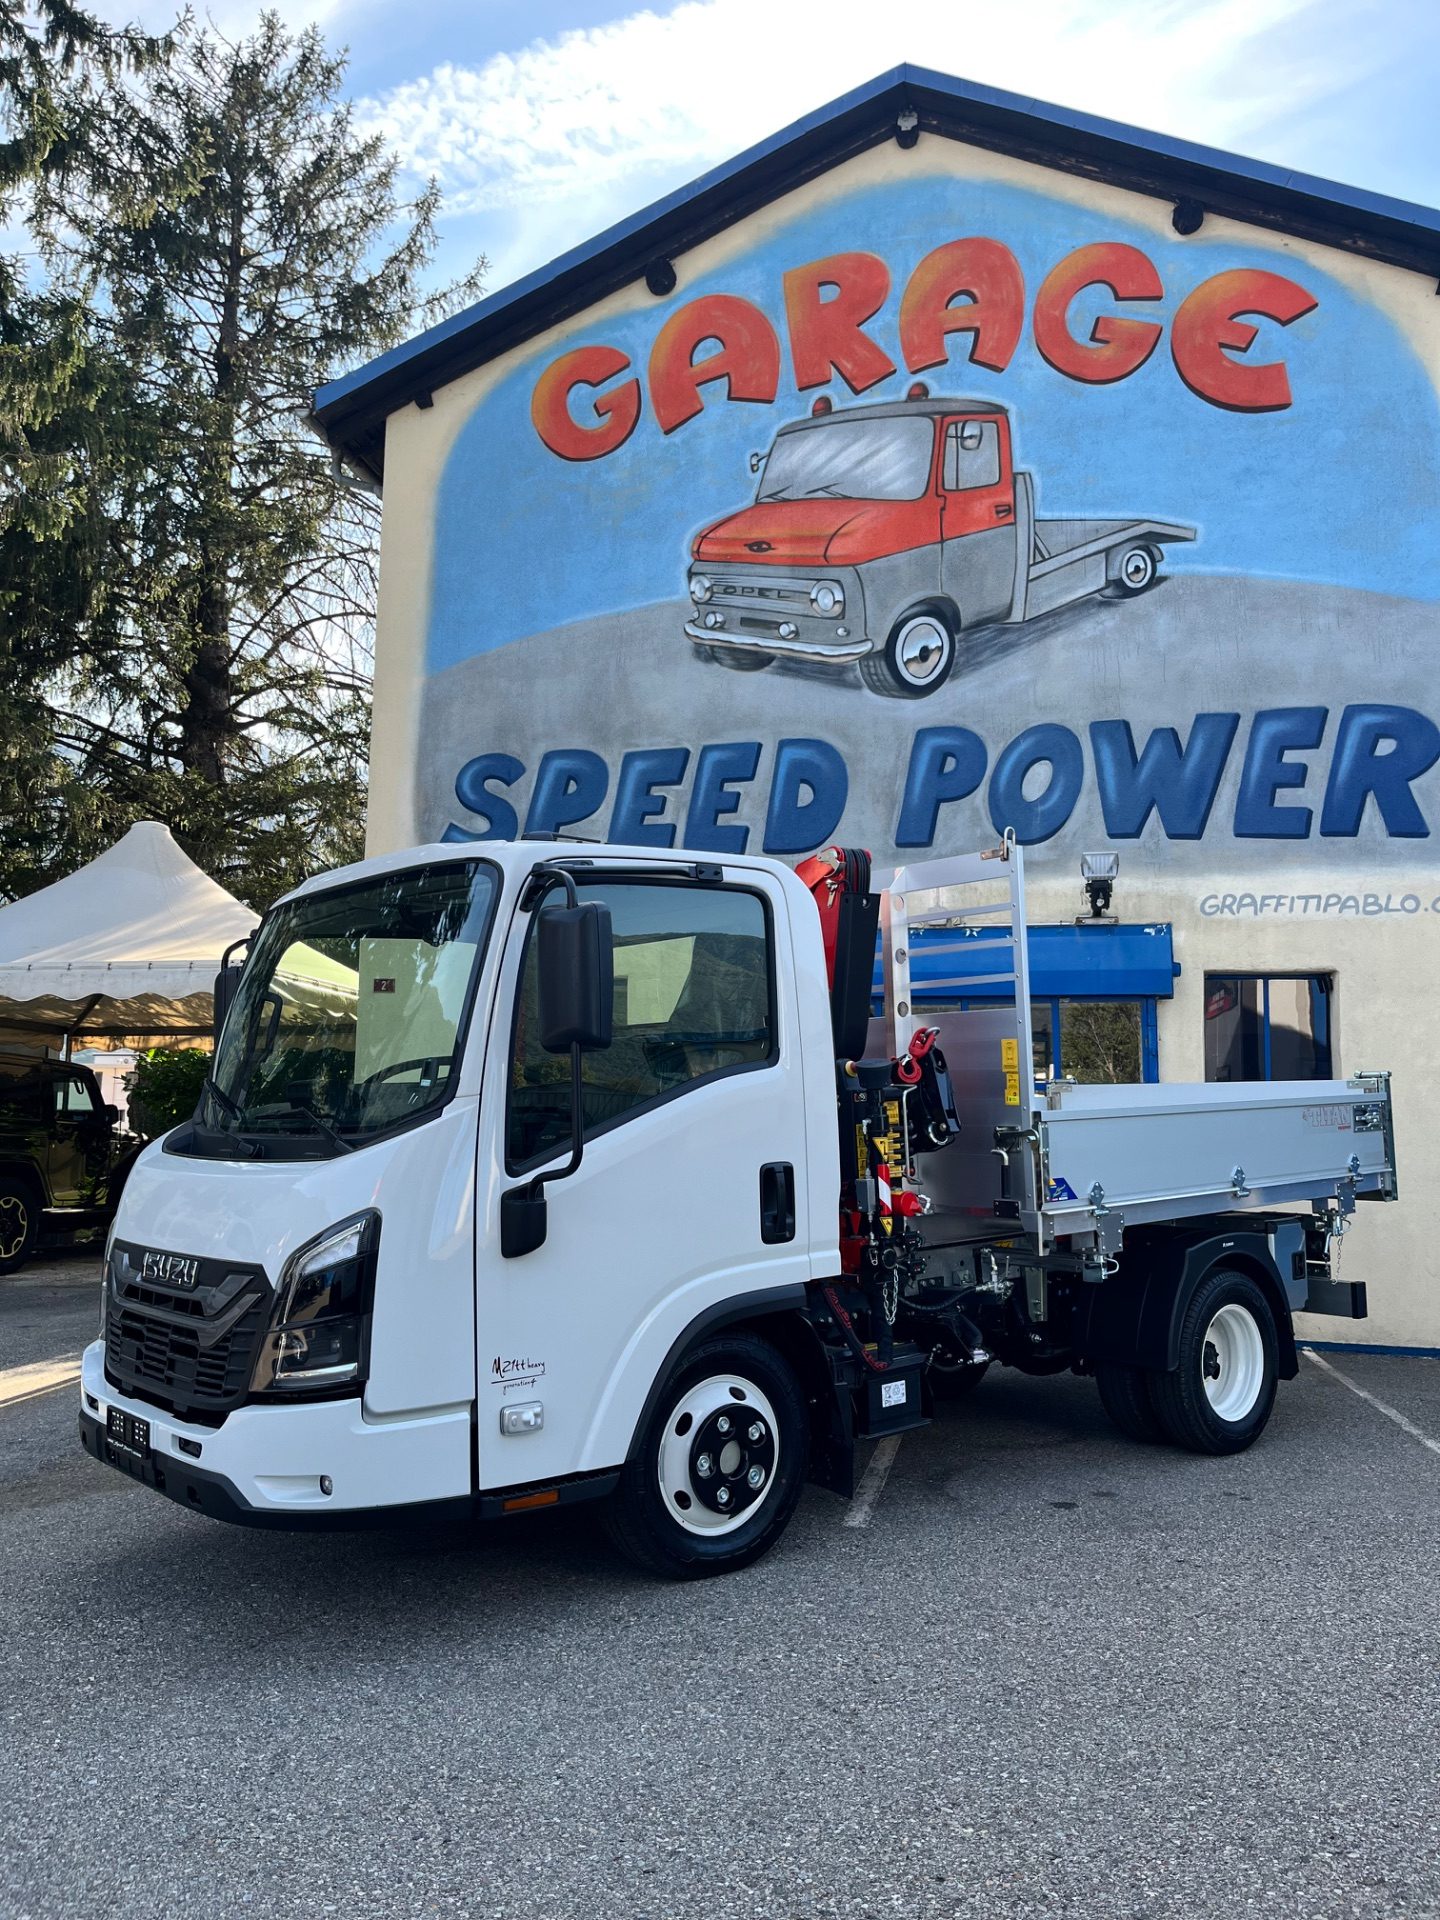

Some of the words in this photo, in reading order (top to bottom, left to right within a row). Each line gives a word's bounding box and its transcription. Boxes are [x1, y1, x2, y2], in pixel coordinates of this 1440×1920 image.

[531, 236, 1319, 462] GARAGE
[723, 585, 791, 599] OPEL
[440, 737, 849, 855] SPEED
[894, 703, 1440, 848] POWER
[142, 1252, 198, 1287] ISUZU
